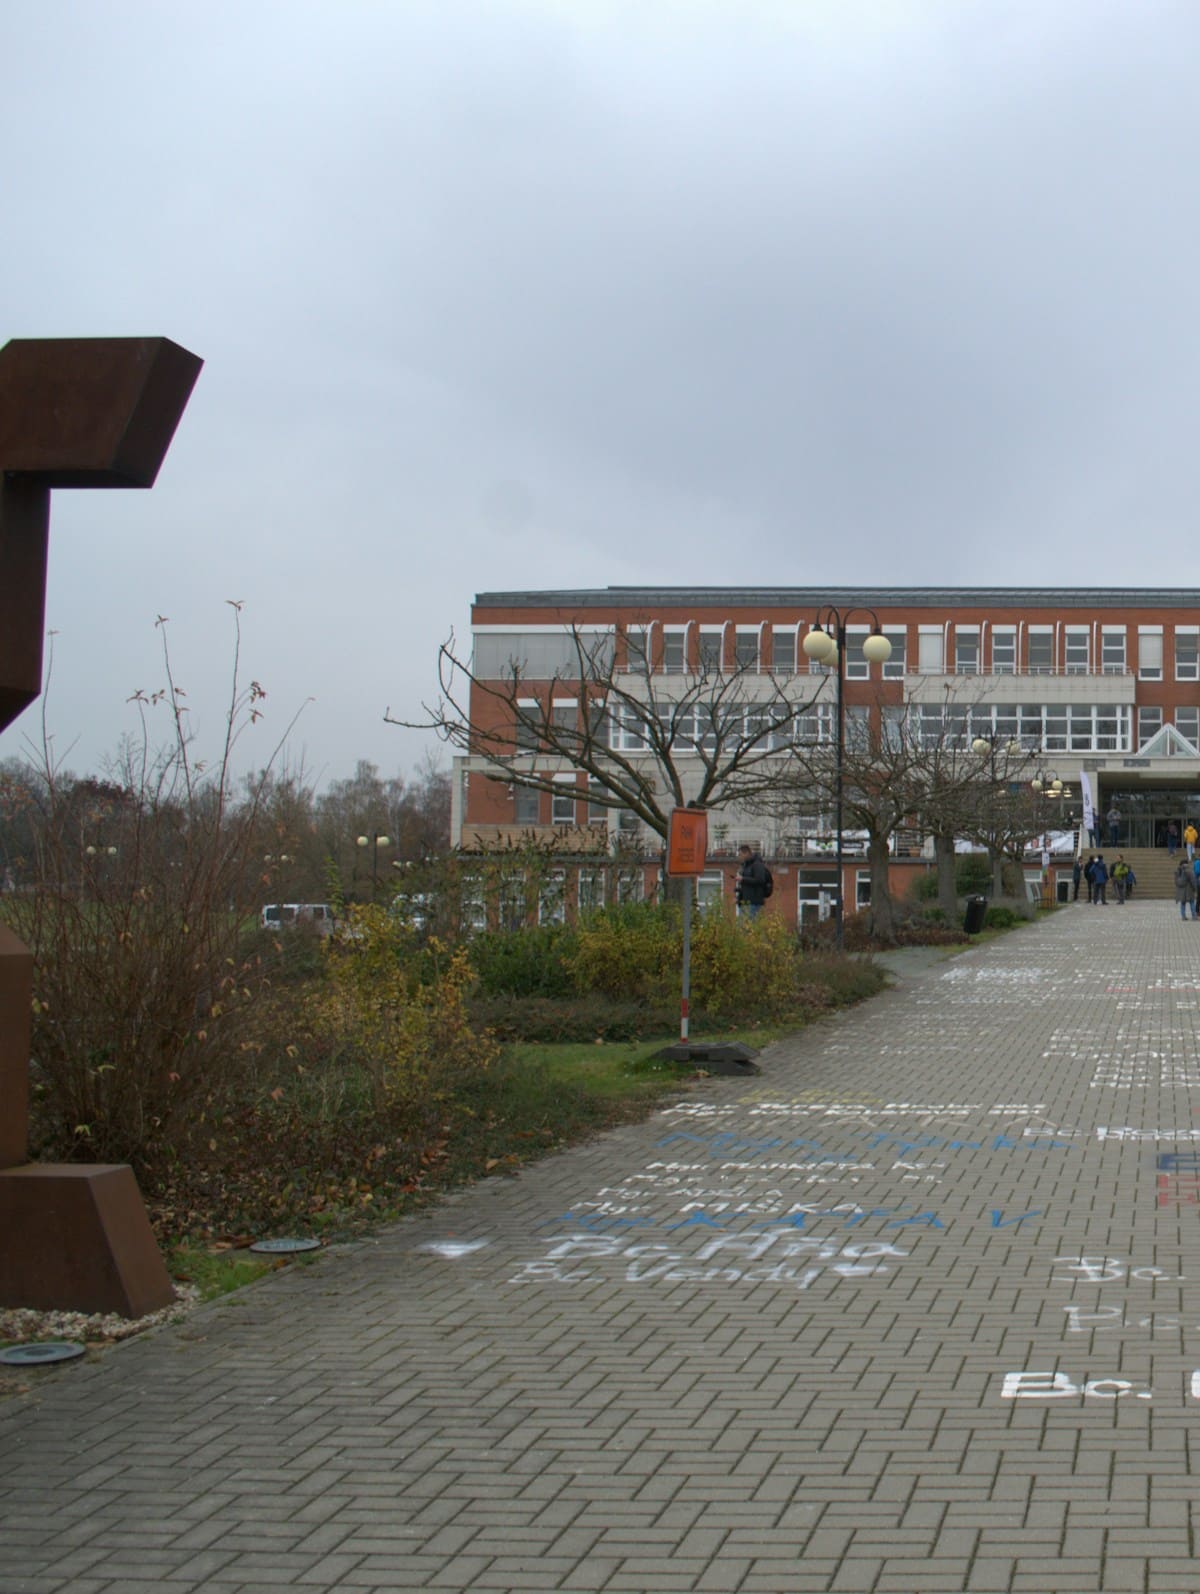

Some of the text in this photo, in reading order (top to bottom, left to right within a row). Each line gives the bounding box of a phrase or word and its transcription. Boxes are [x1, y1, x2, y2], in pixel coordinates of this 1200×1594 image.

[623, 1260, 827, 1290] Vendy
[1050, 1255, 1187, 1283] Bc.
[1001, 1370, 1153, 1400] Bc.
